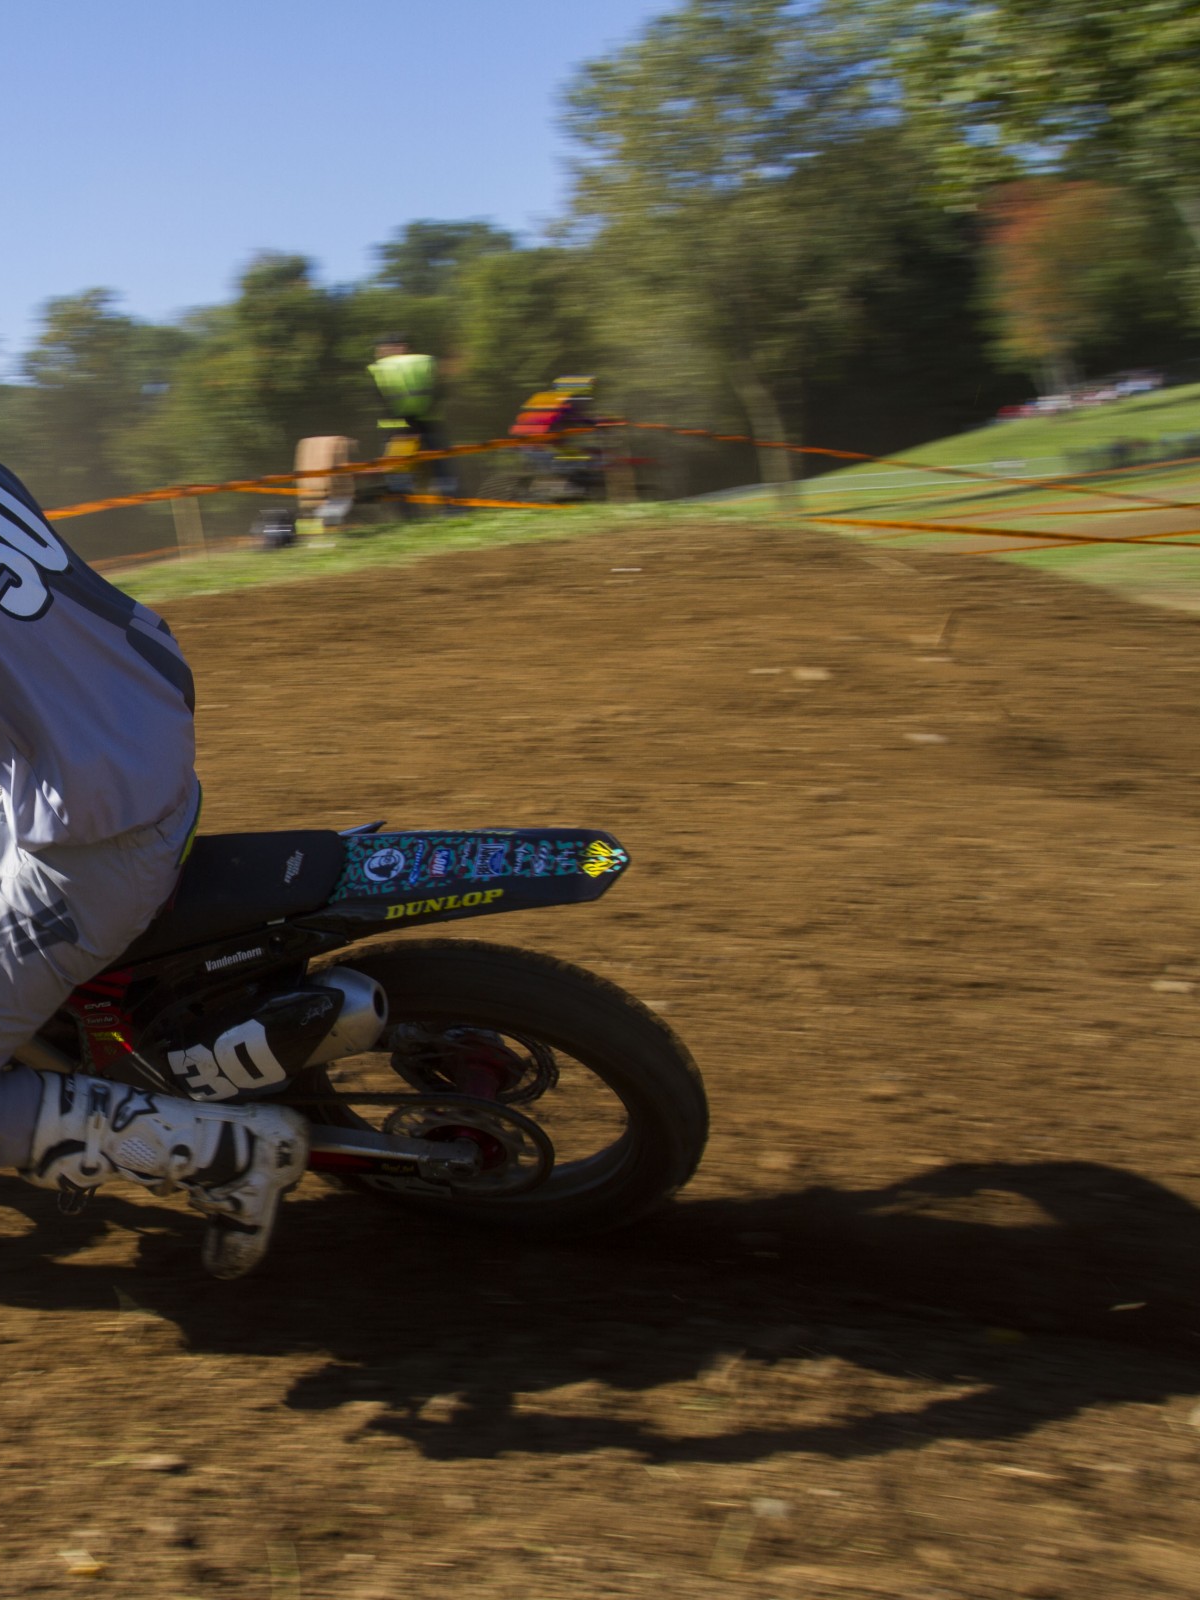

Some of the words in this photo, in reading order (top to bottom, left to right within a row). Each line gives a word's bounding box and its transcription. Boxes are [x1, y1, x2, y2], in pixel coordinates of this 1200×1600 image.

[385, 889, 504, 920] DUNLOP
[205, 946, 263, 972] VandenToorn
[167, 1019, 286, 1101] 30
